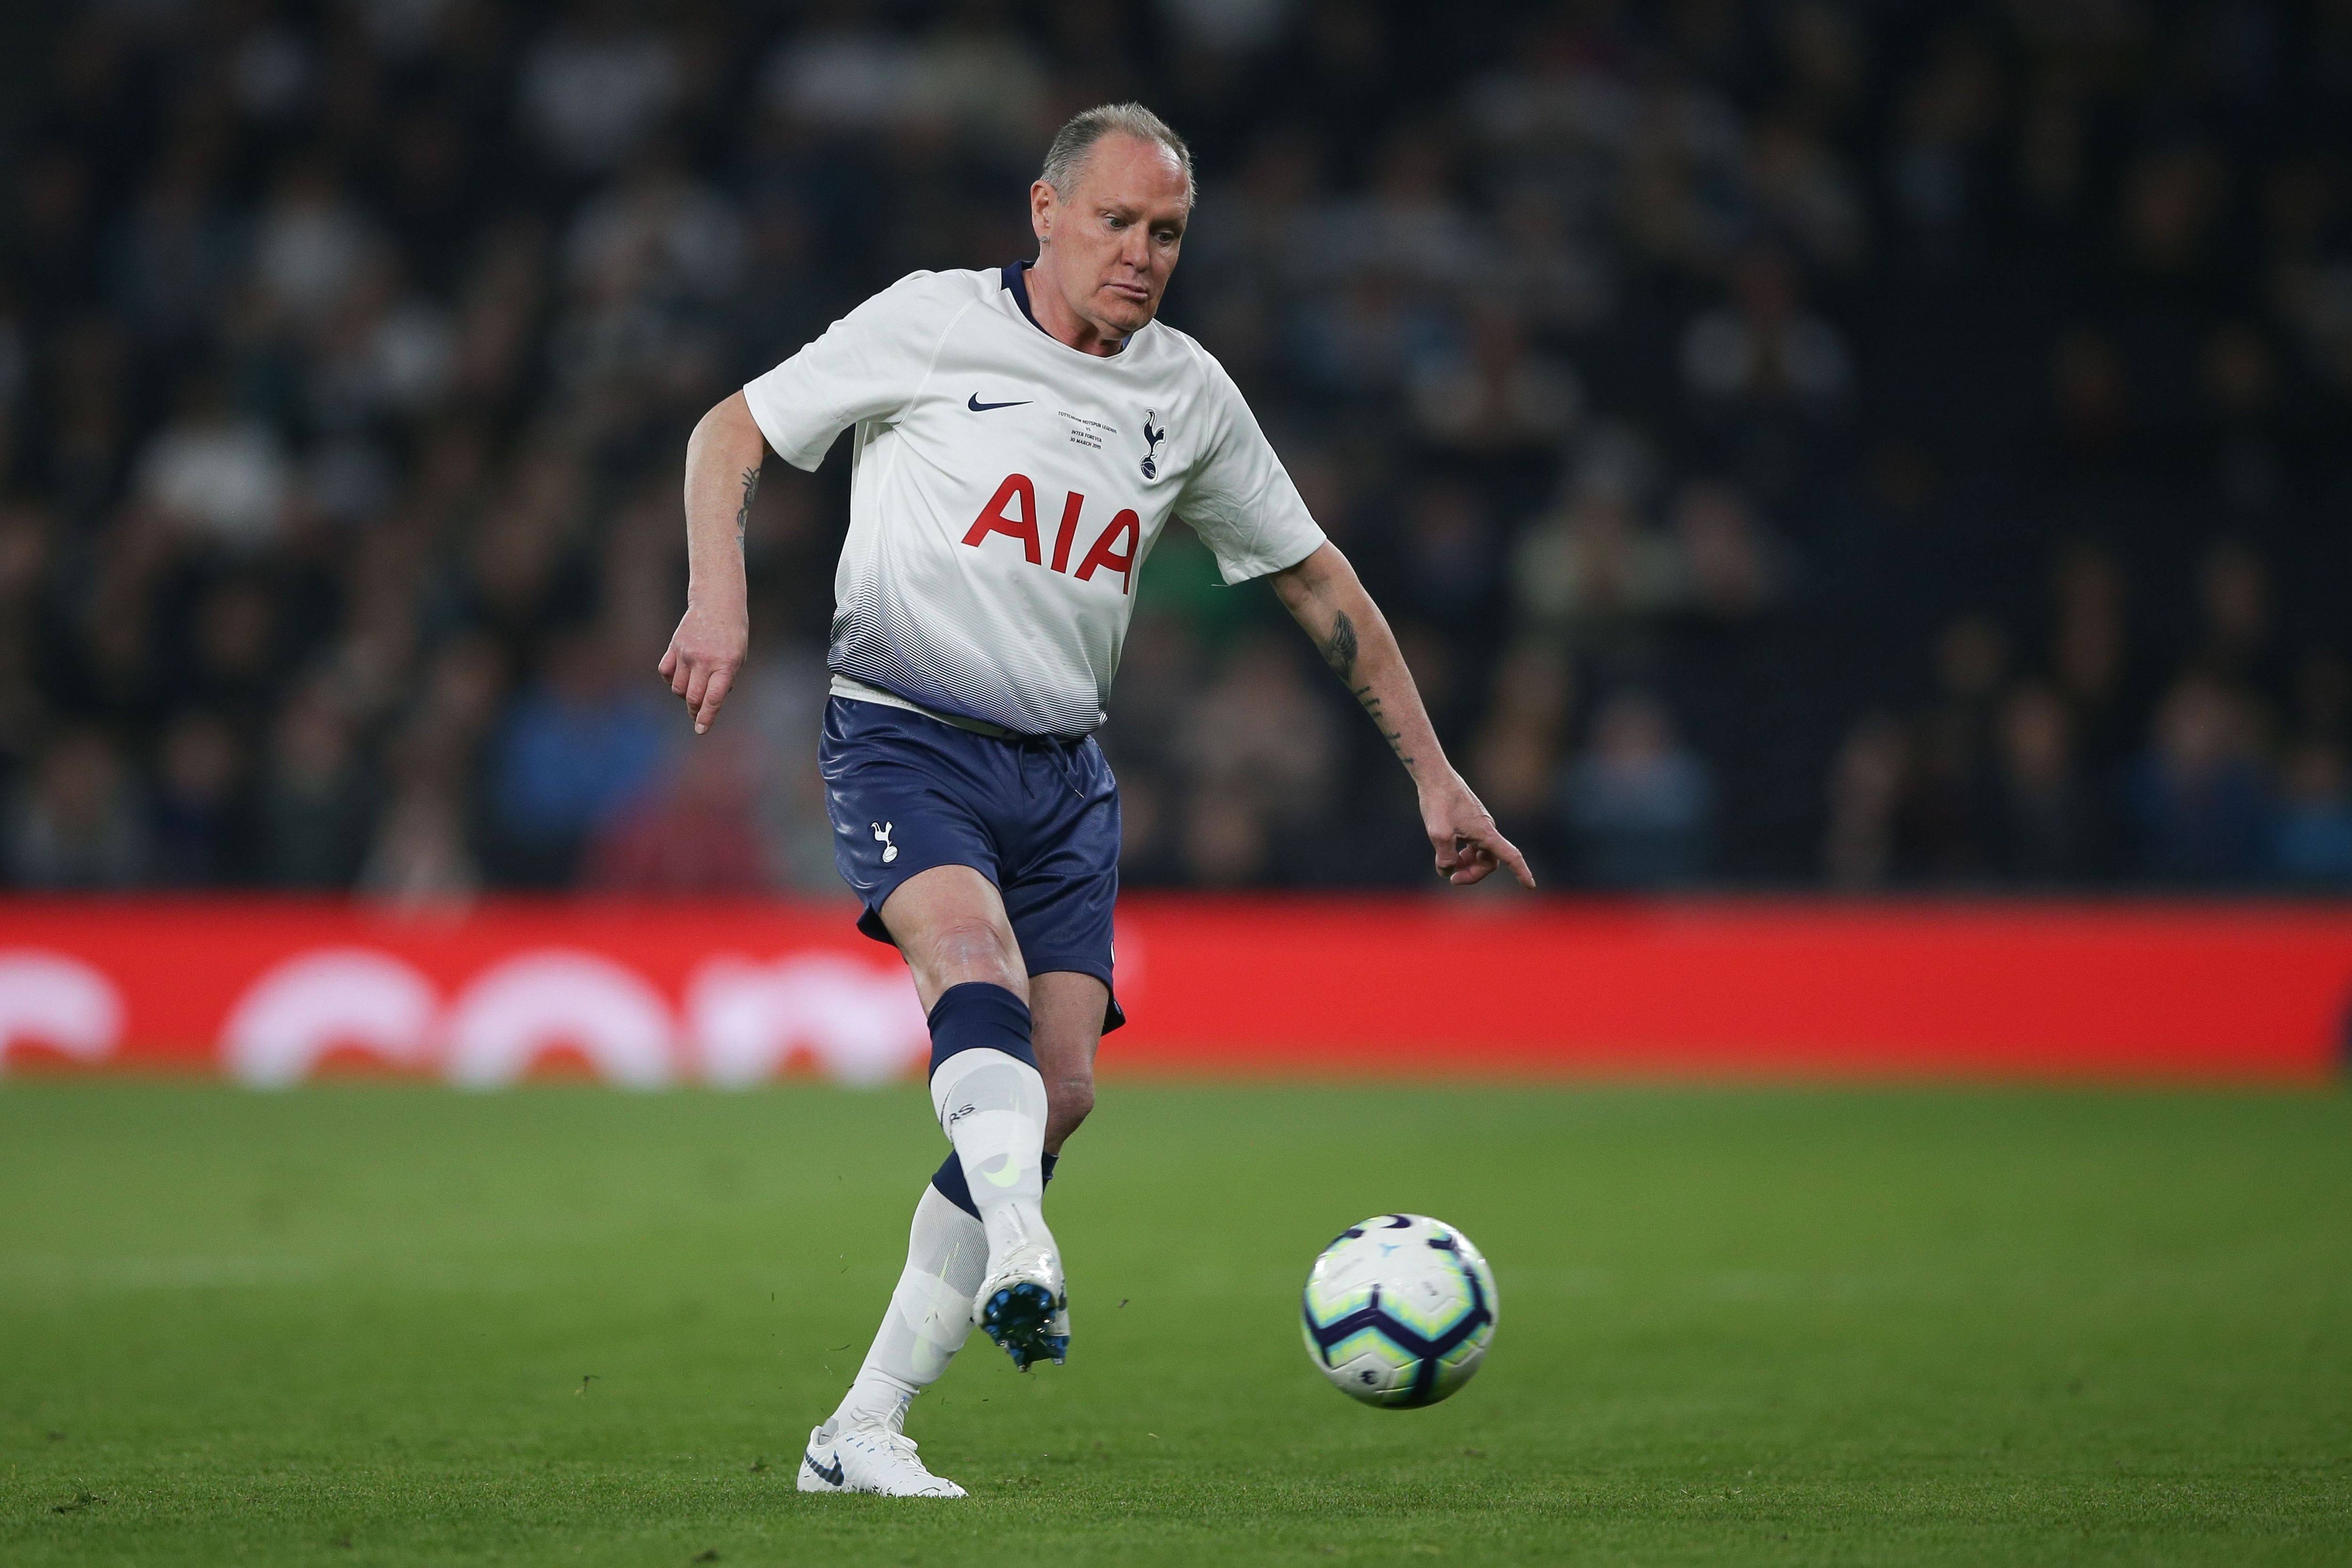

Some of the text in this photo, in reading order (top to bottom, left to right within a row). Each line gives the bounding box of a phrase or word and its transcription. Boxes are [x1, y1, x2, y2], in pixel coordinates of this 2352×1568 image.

[1058, 411, 1082, 423] TOTTENHAM
[1102, 424, 1117, 433] LEGENDS
[1084, 433, 1102, 442] FOREVER
[961, 473, 1140, 595] AIA
